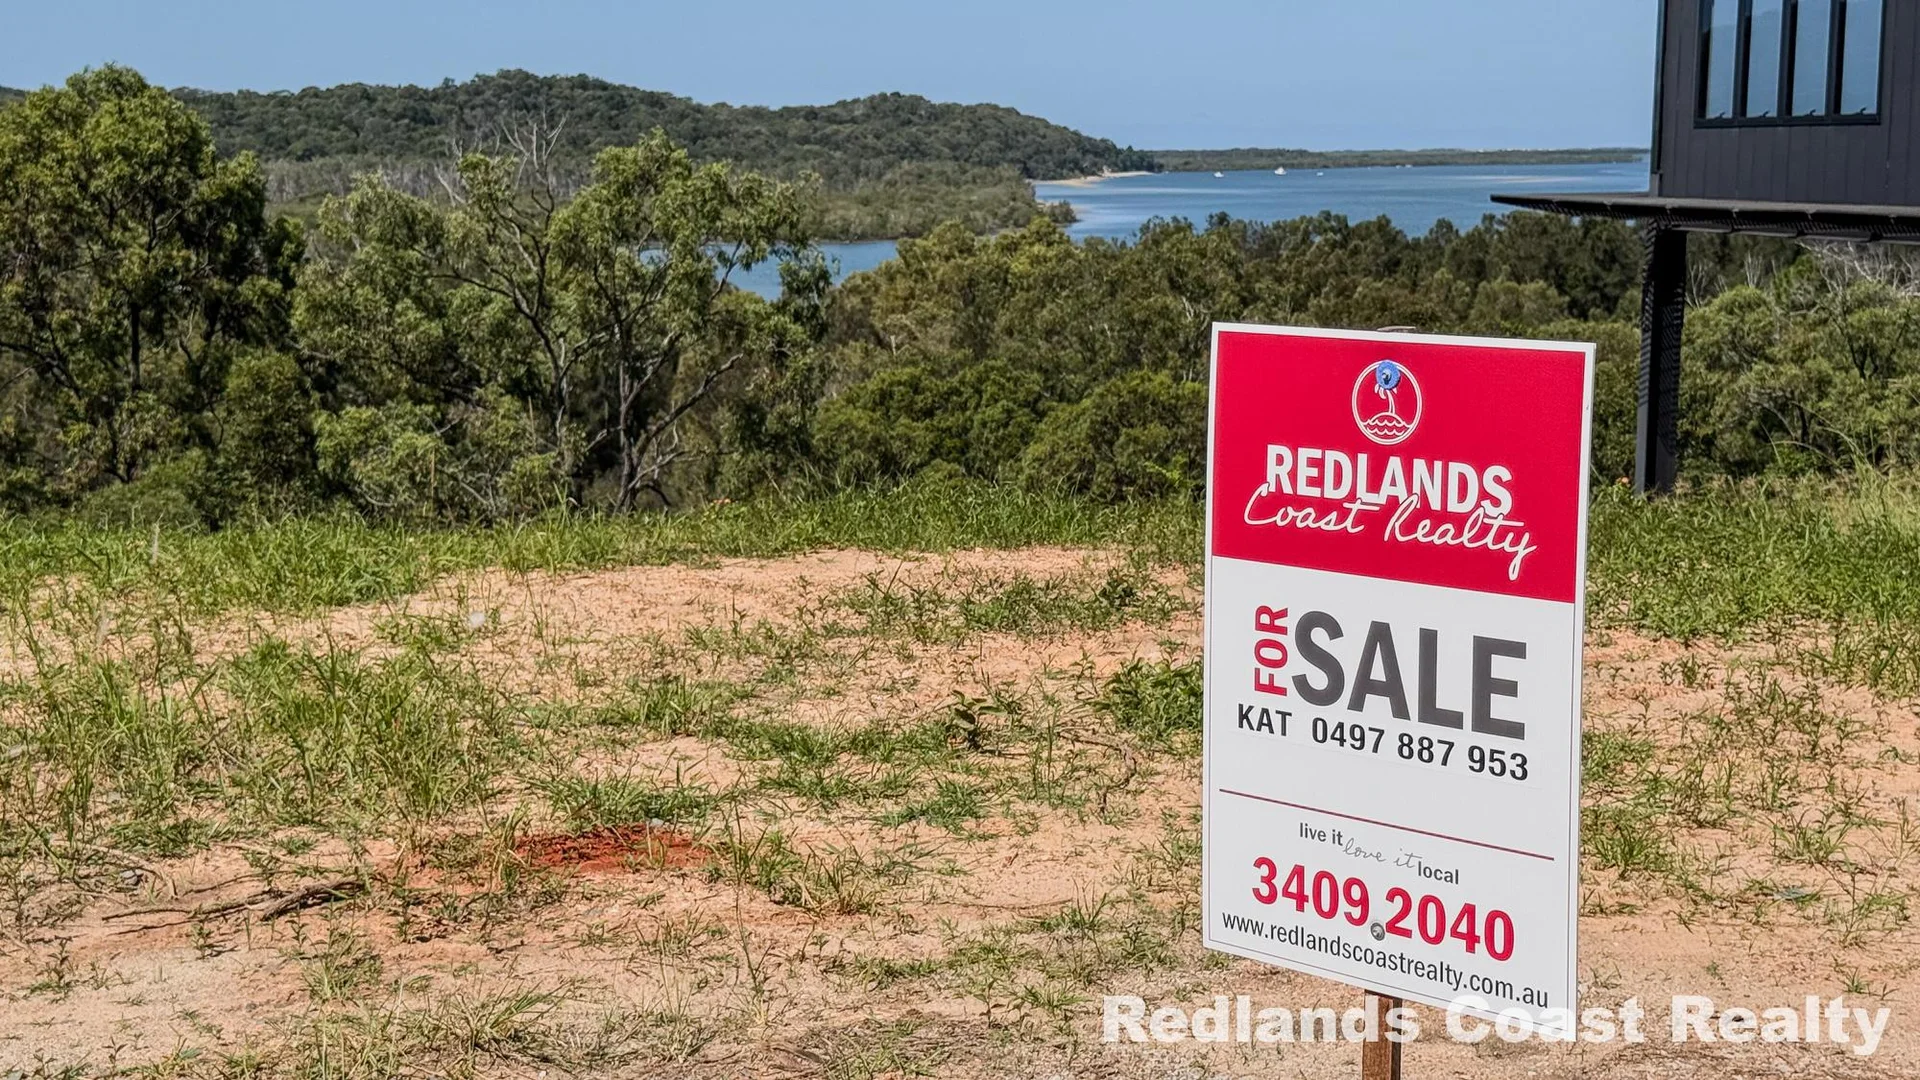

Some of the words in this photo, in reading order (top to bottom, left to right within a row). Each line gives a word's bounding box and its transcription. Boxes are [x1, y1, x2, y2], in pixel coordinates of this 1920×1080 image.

[1267, 444, 1513, 518] REDLANDS
[1244, 482, 1380, 533] Coast
[1384, 493, 1537, 581] Realty
[1254, 605, 1288, 697] FOR
[1291, 610, 1527, 741] SALE
[1238, 703, 1292, 737] KAT
[1312, 717, 1385, 754] 0497
[1397, 732, 1455, 767] 887
[1468, 745, 1529, 781] 953
[1299, 822, 1327, 843] live
[1332, 828, 1343, 846] it
[1342, 837, 1386, 863] love
[1395, 848, 1422, 869] it
[1417, 861, 1459, 885] local
[1252, 857, 1370, 927] 3409
[1385, 887, 1515, 962] 2040
[1222, 911, 1549, 1009] www.redlandscoastrealty.com.au
